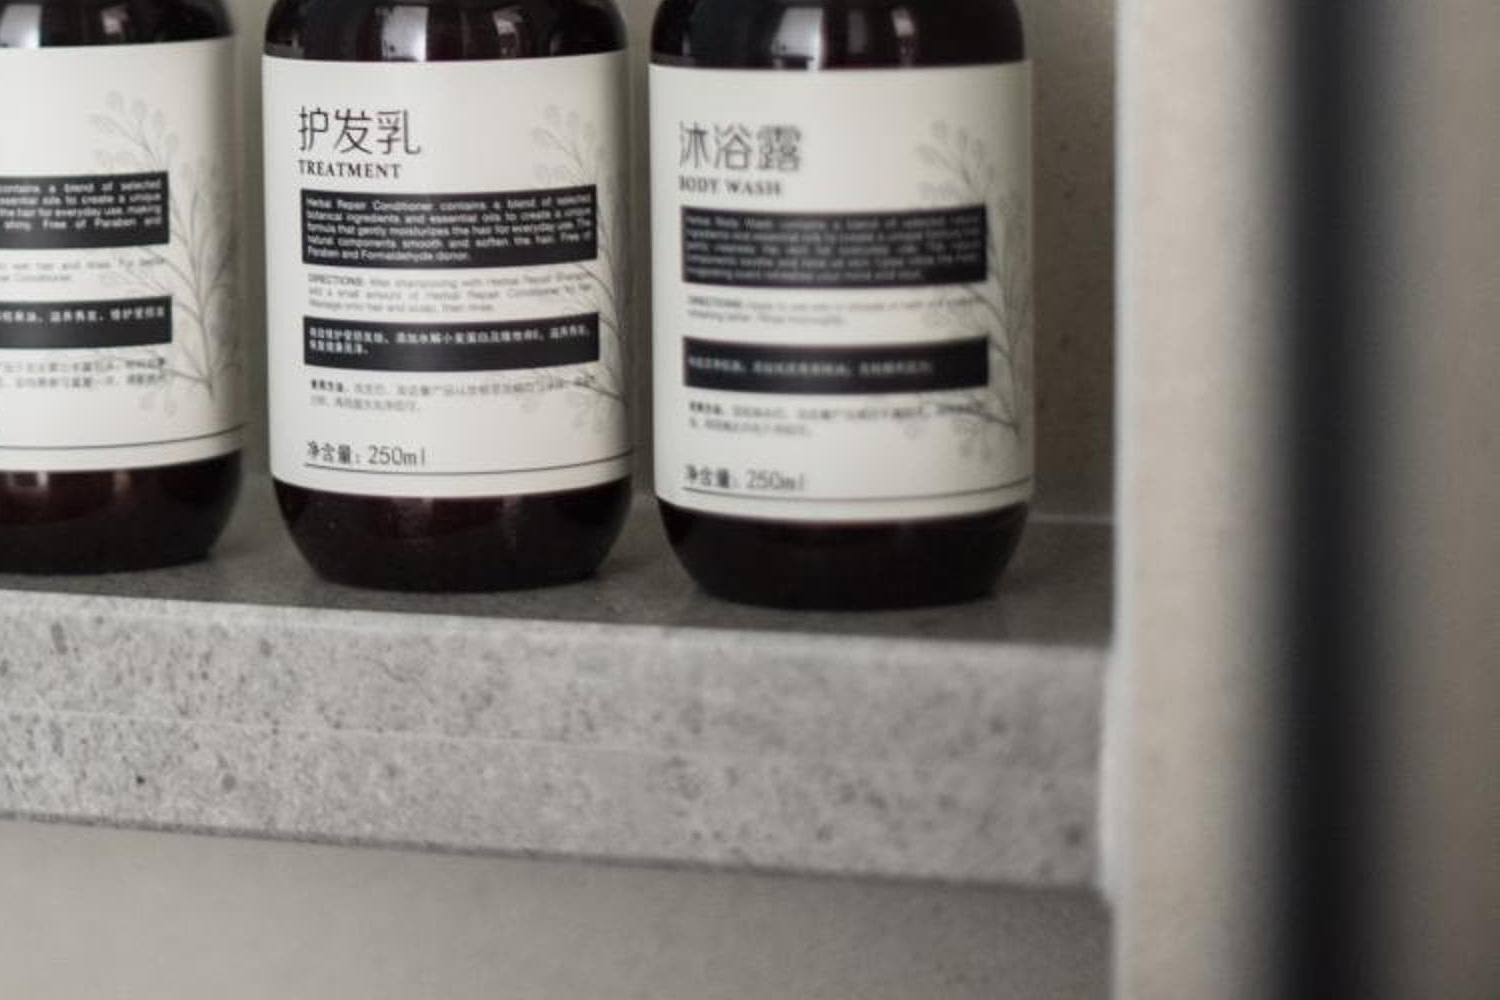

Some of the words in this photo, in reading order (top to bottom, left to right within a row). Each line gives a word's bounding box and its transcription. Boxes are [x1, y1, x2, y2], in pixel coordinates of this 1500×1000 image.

[297, 105, 421, 155] 护发乳
[679, 119, 801, 172] 沐浴露
[298, 159, 402, 179] TREATMENT
[679, 175, 718, 194] BODY
[725, 179, 781, 197] WASH
